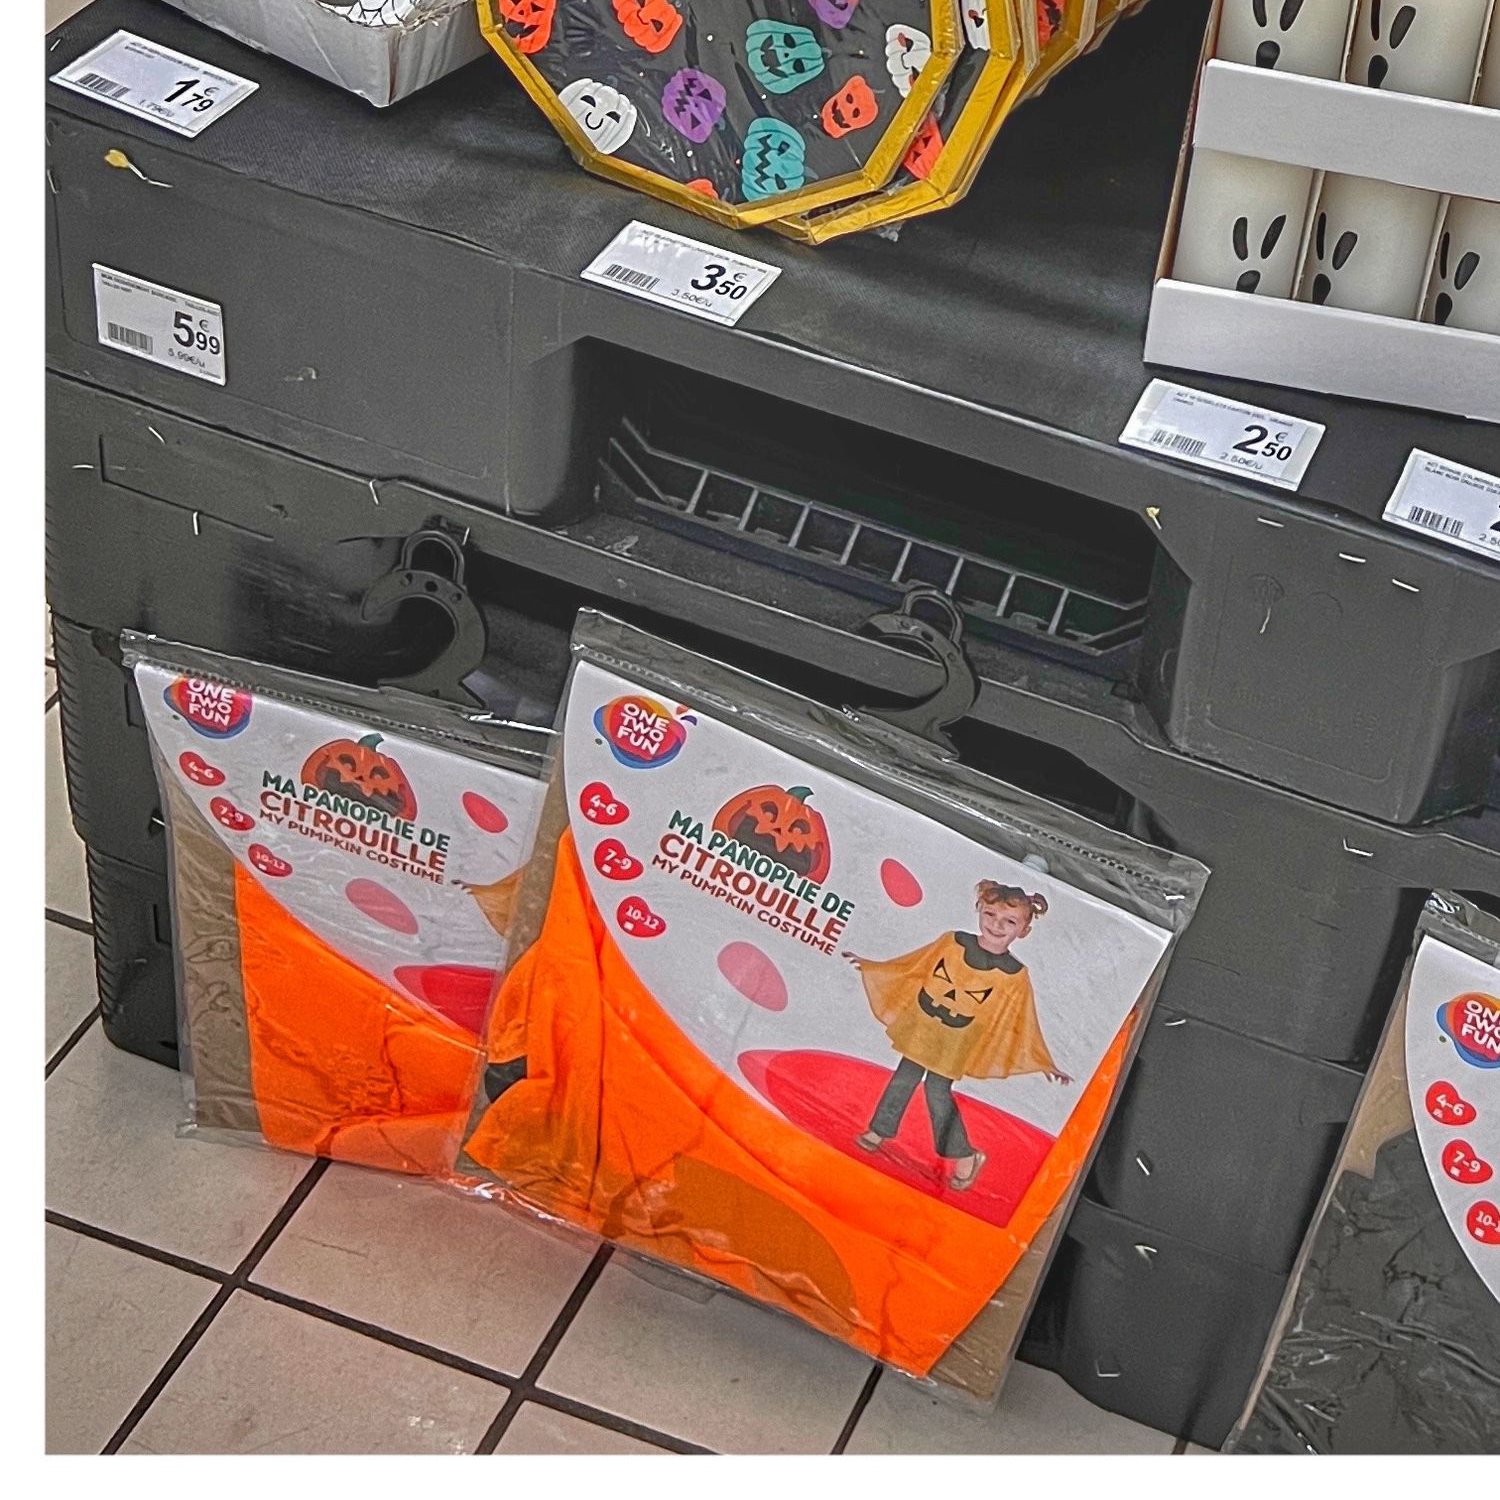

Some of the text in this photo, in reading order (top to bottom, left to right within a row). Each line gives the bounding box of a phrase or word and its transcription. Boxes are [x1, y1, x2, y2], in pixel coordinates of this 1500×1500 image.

[188, 678, 233, 704] ONE
[188, 689, 232, 714] TWO
[188, 701, 230, 728] FUN
[620, 714, 664, 743] TWO
[623, 702, 669, 732] ONE
[617, 727, 660, 755] FUN
[262, 771, 450, 852] MA PANOPLIE DE
[590, 794, 617, 816] 4-6
[260, 792, 446, 872] CITROUILLE
[260, 809, 444, 885] MY PUMPKIN COSTUME
[607, 849, 632, 870] 7-9
[669, 810, 855, 921] MA PANOPLIE DE
[660, 833, 846, 942] CITROUILLE
[626, 905, 660, 930] 10-12
[652, 854, 835, 956] MY PUMPKIN COSTUME
[1436, 1094, 1464, 1116] 4-6
[1454, 1151, 1481, 1174] 7-9
